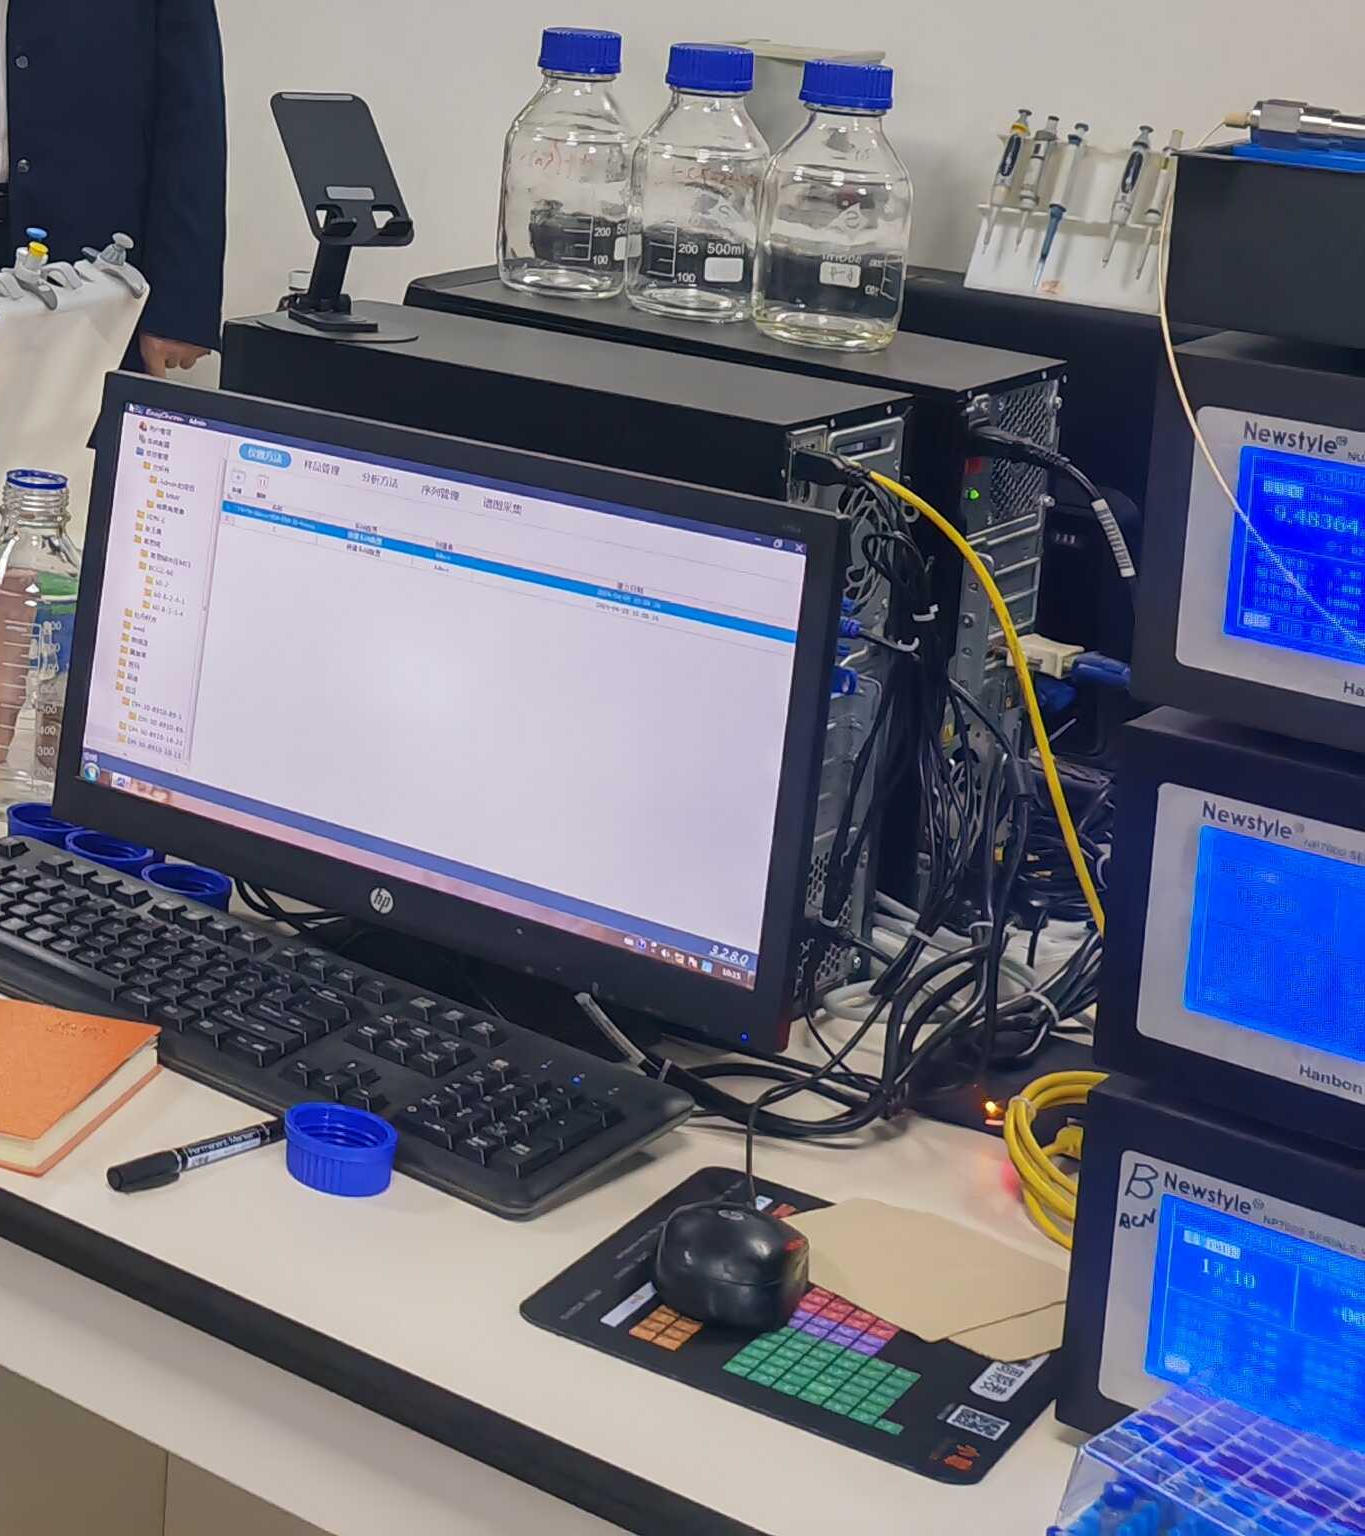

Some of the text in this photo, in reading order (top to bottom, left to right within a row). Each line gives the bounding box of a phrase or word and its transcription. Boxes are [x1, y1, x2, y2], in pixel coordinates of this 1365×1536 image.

[594, 227, 611, 237] 200
[678, 242, 745, 256] 200 500ml
[593, 255, 608, 265] 100
[677, 272, 696, 283] 100
[1243, 420, 1338, 454] Newstyle
[303, 458, 341, 476] 样品管理
[361, 472, 399, 489] 分析方法
[1202, 799, 1293, 840] Newstyle
[372, 887, 391, 913] hp
[1124, 1162, 1159, 1200] B
[1164, 1171, 1252, 1215] Newstyle
